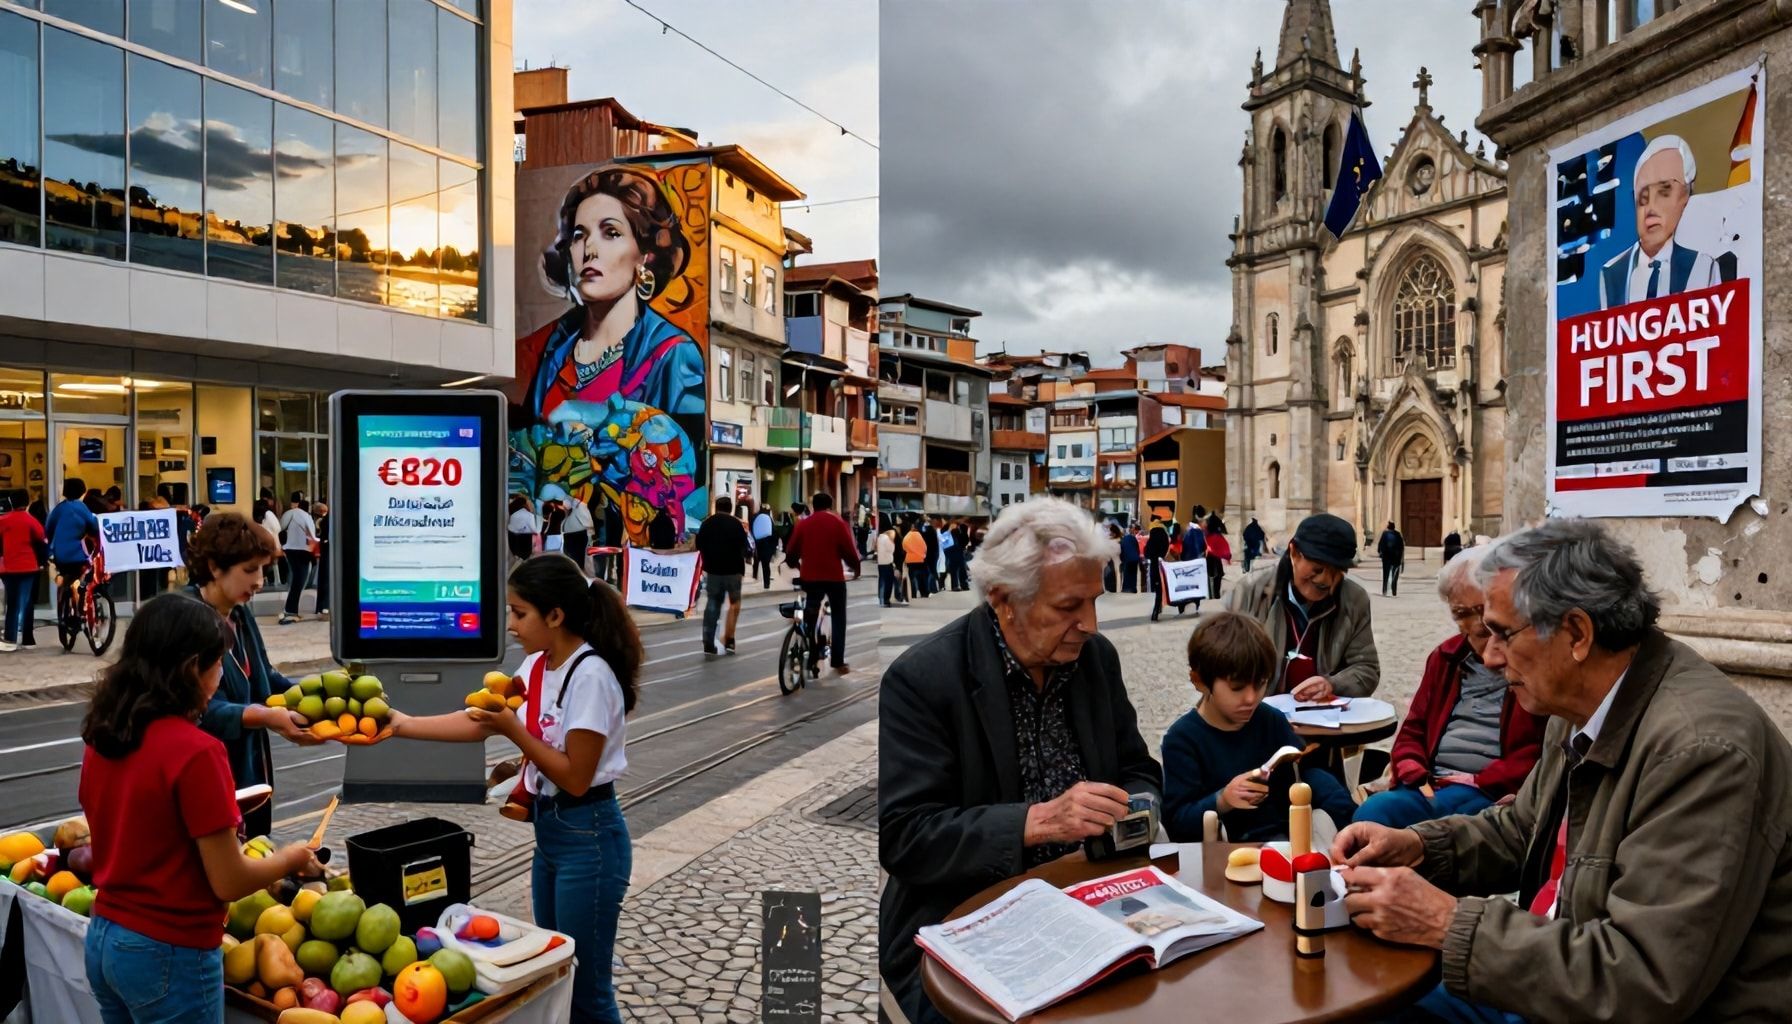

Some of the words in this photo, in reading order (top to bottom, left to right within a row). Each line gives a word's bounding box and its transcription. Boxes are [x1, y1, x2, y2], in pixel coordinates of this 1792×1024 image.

[1571, 289, 1736, 353] HUNGARY
[1579, 335, 1720, 407] FIRST
[377, 457, 463, 486] €820
